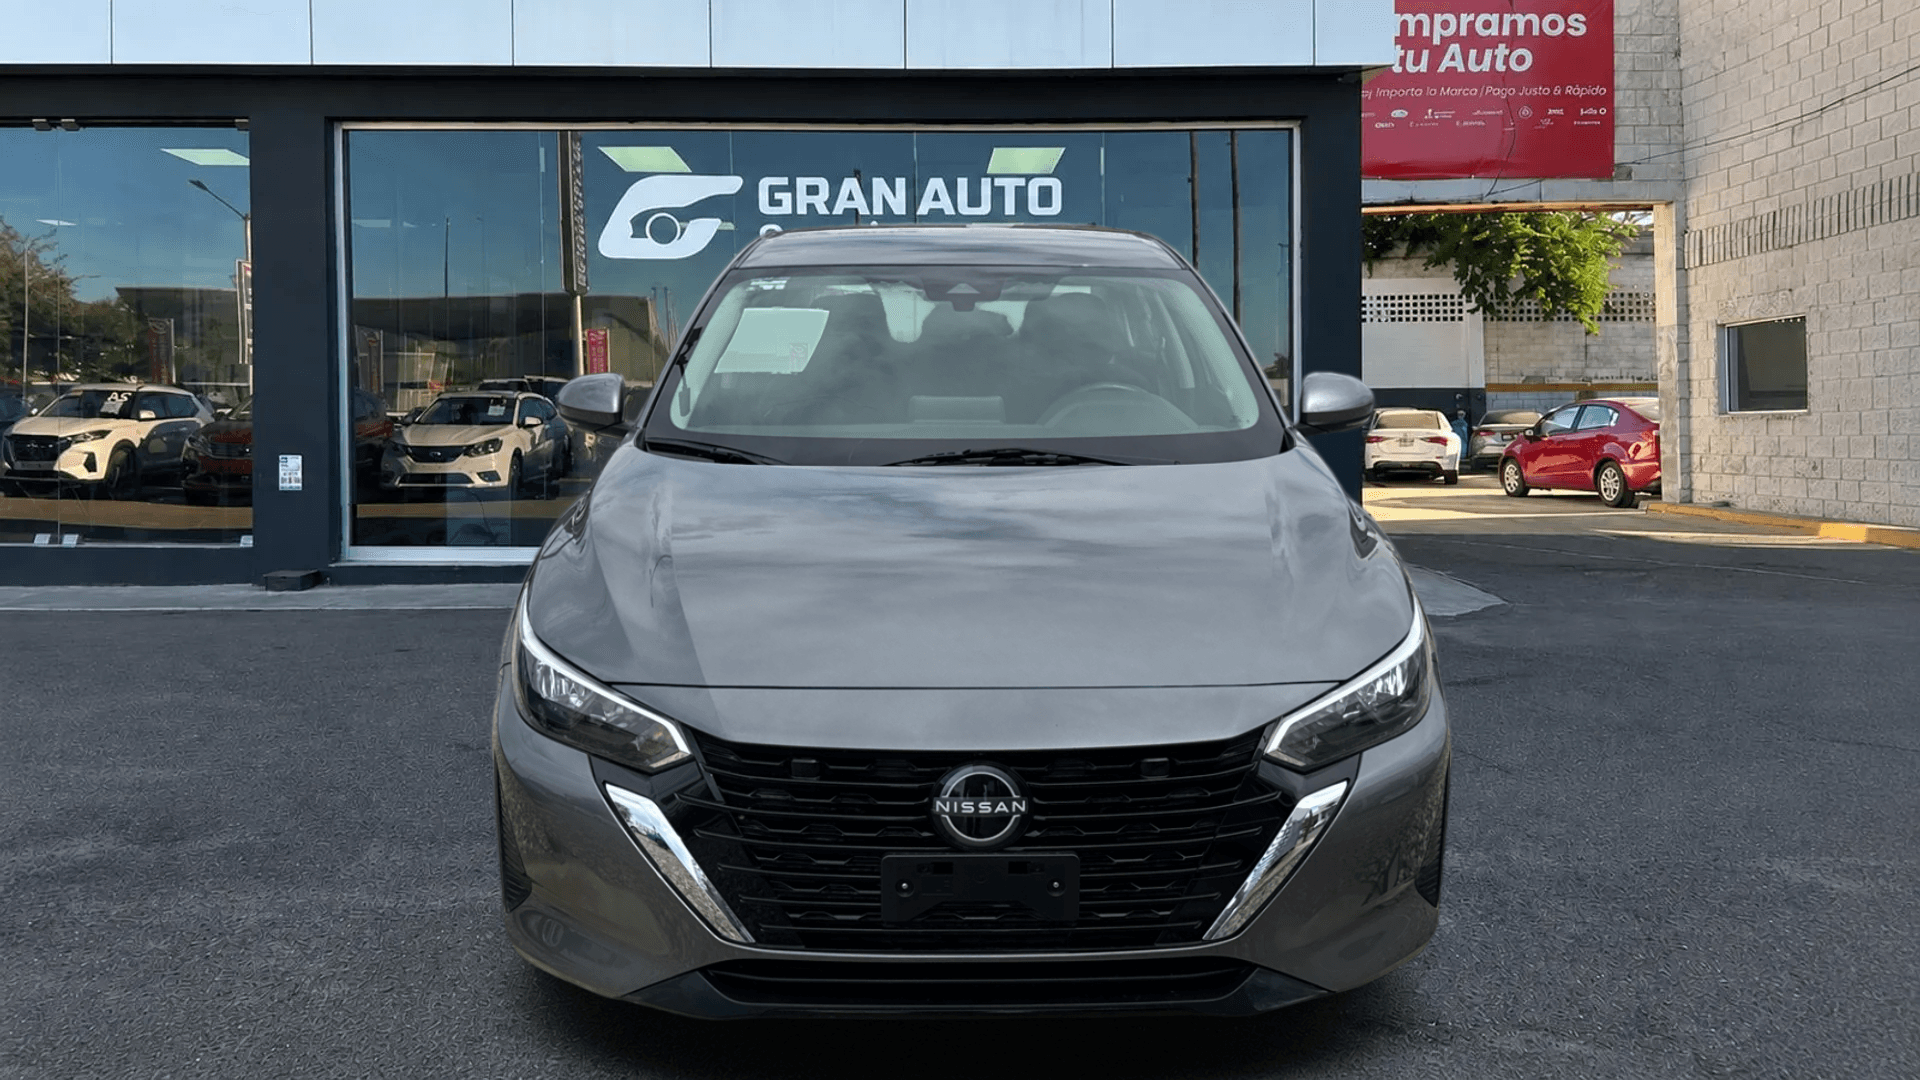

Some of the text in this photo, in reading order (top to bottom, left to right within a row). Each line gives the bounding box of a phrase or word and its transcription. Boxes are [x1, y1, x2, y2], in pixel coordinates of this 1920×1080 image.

[1393, 43, 1533, 73] tu Auto
[1376, 87, 1423, 99] Importa
[1426, 87, 1437, 97] la
[1519, 86, 1551, 96] Justo
[1553, 85, 1562, 96] &
[758, 176, 1063, 216] GRAN AUTO
[935, 799, 1026, 814] NISSAN
